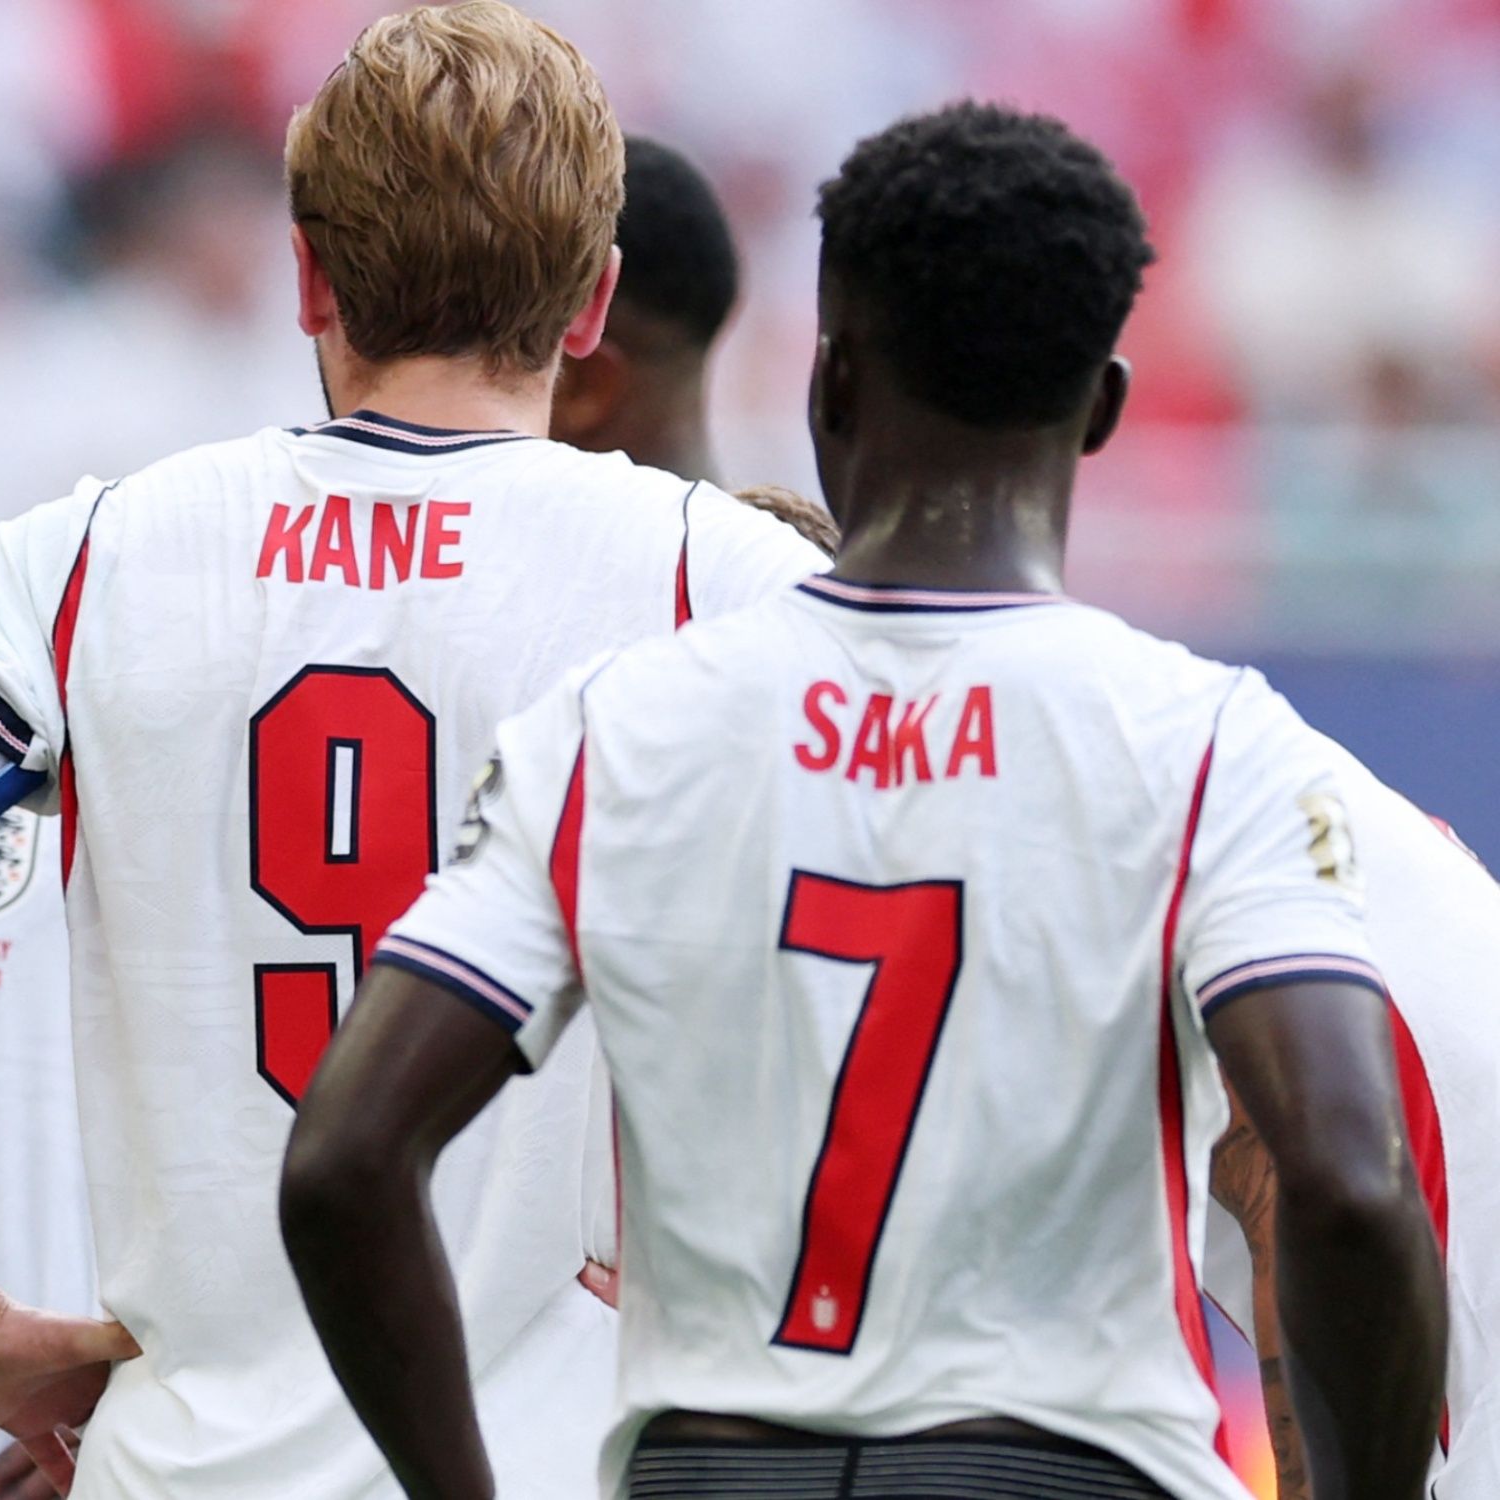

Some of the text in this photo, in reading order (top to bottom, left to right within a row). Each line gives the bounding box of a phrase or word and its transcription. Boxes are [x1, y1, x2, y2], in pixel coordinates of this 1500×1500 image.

[256, 495, 471, 590] KANE
[794, 680, 997, 789] SAKA
[249, 664, 439, 1112] 9
[769, 868, 964, 1356] 7
